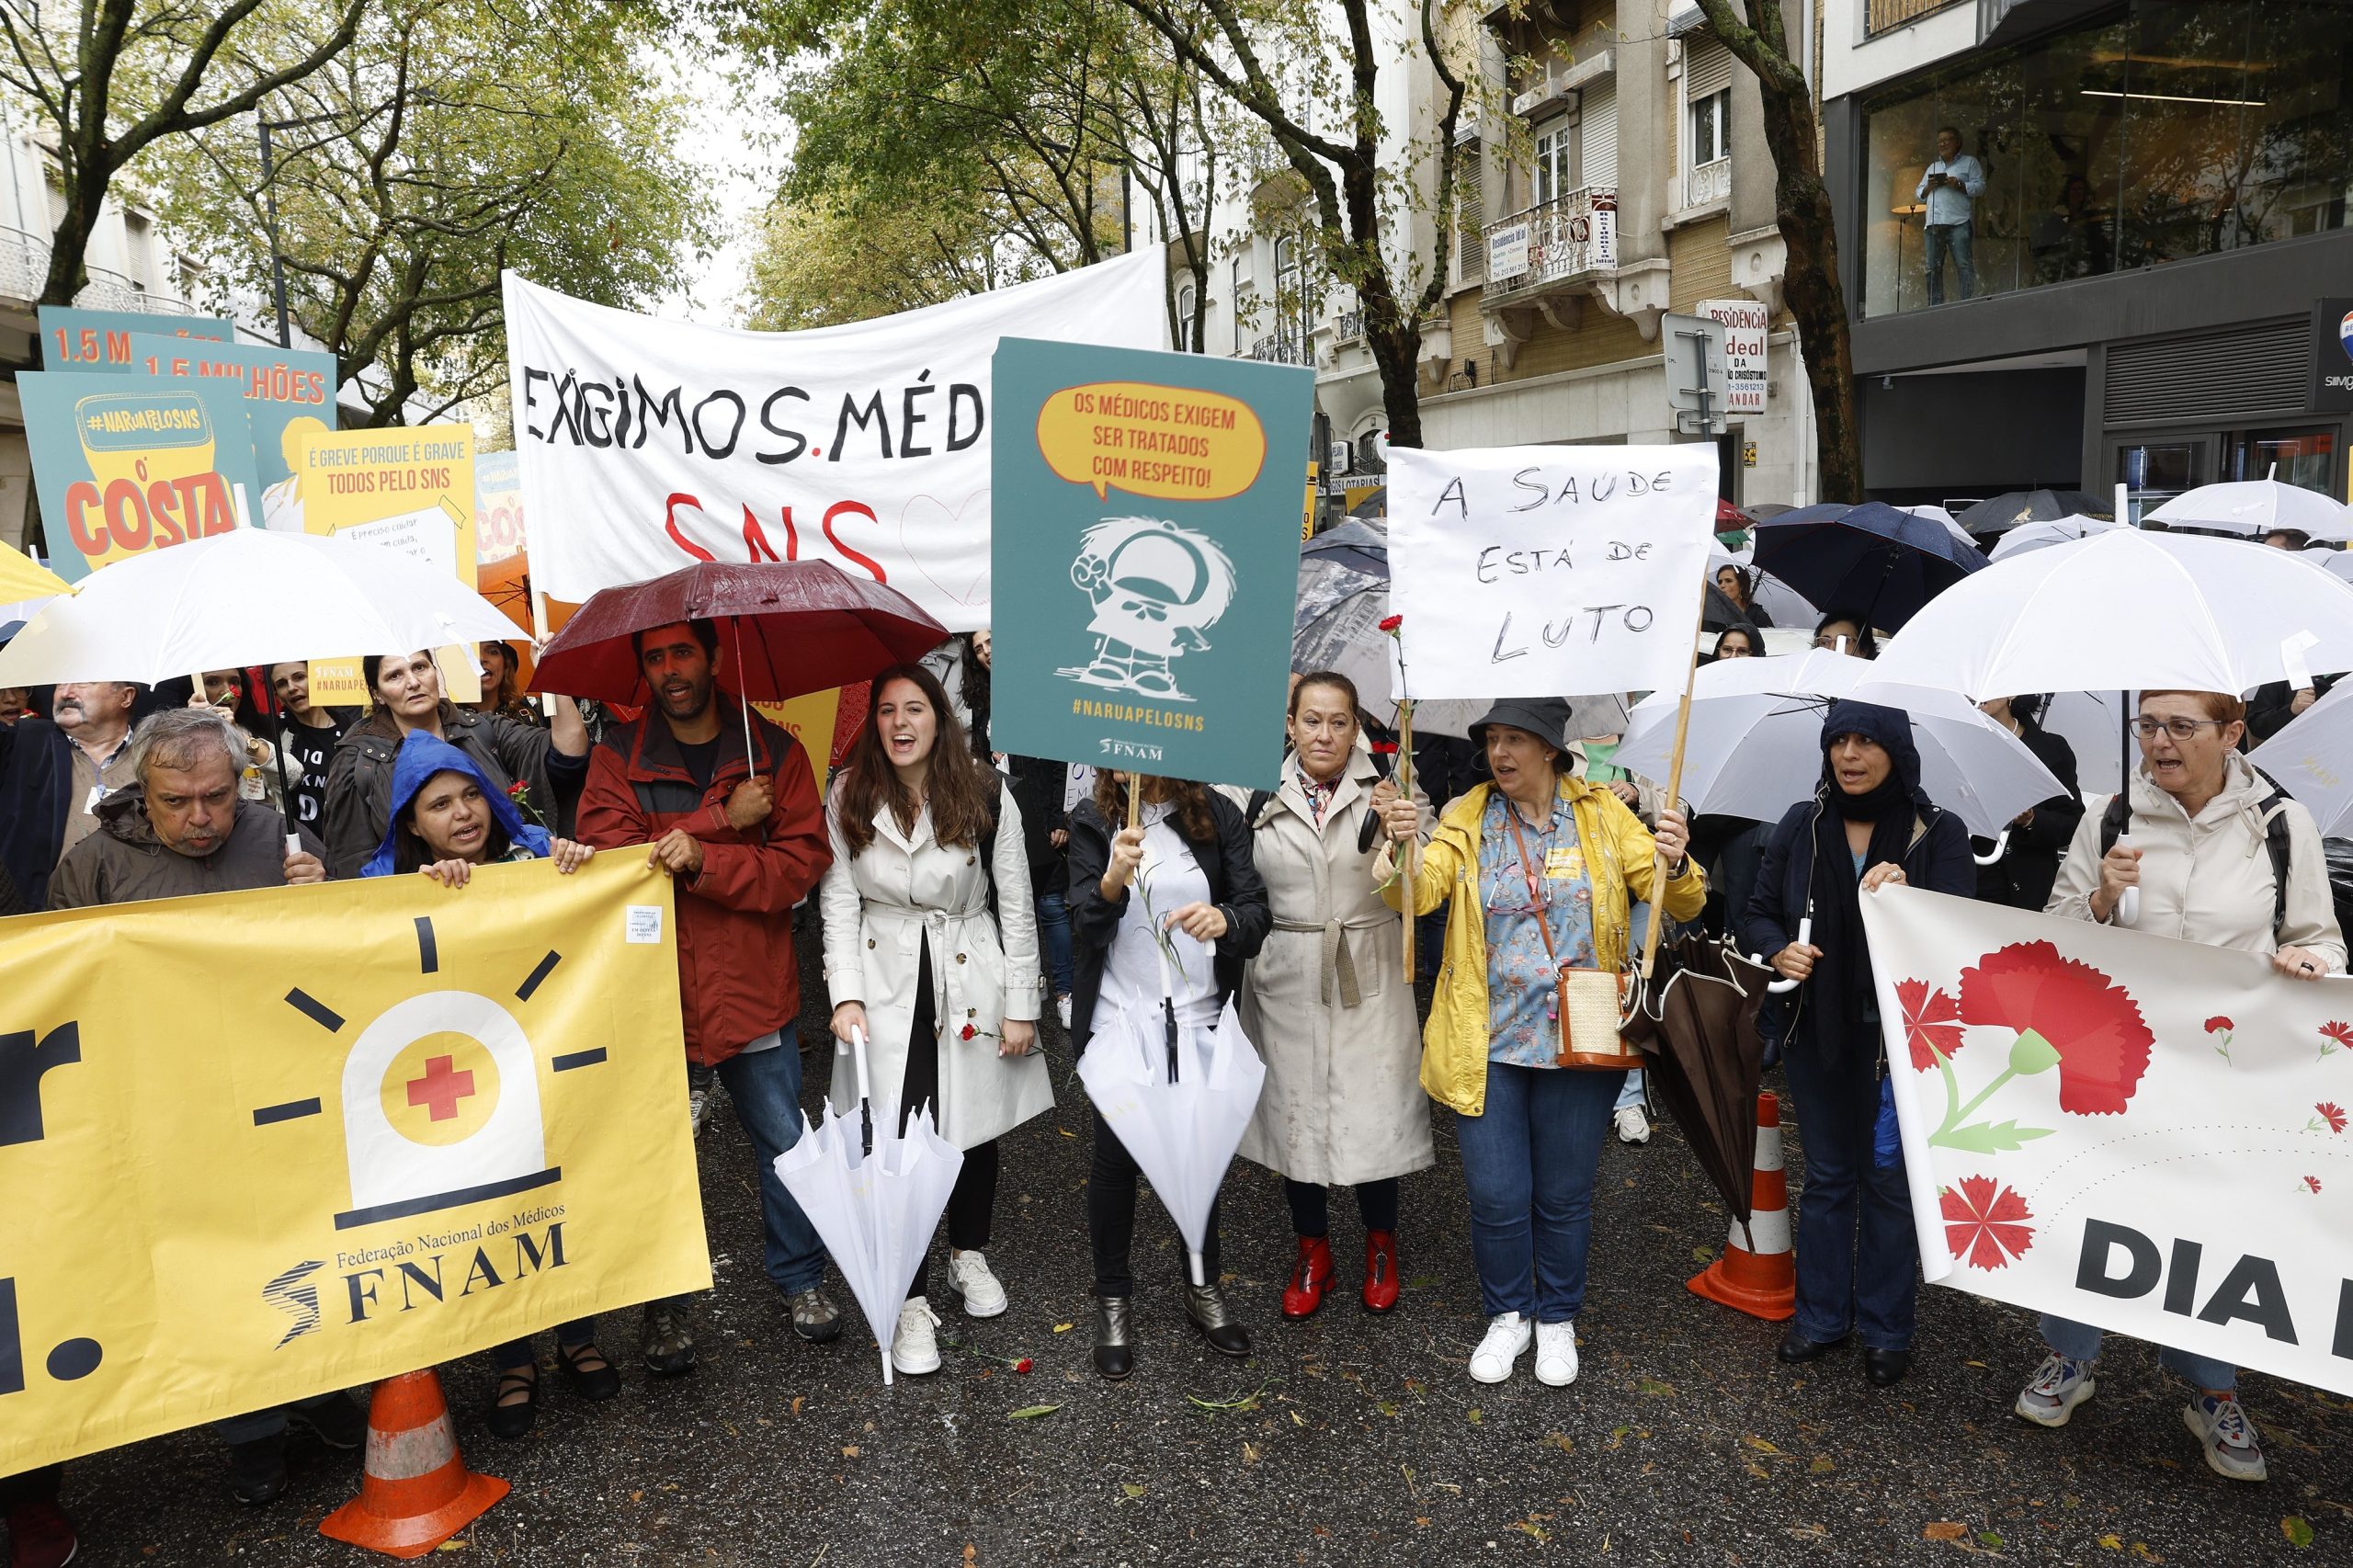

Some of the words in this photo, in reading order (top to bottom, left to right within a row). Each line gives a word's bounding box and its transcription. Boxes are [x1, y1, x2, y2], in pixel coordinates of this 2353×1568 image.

[1726, 335, 1763, 356] deal
[1733, 358, 1746, 368] DA
[1728, 382, 1765, 392] 1-3561213
[1729, 393, 1760, 406] ANDAR
[828, 369, 984, 461] MÉD
[1074, 392, 1094, 414] OS
[1099, 393, 1169, 423] MÉDICOS
[1174, 404, 1235, 430] EXIGEM
[309, 448, 316, 467] É
[320, 448, 358, 467] GREVE
[362, 445, 409, 464] PORQUE
[414, 441, 421, 461] É
[425, 441, 465, 460] GRAVE
[1094, 425, 1123, 448] SER
[1129, 428, 1210, 458] TRATADOS
[327, 472, 375, 494] TODOS
[380, 469, 416, 492] PELO
[421, 467, 450, 489] SNS
[1092, 456, 1127, 478] COM
[1131, 460, 1211, 489] RESPEITO!
[1431, 476, 1469, 522] A
[1507, 465, 1672, 513] SAÚDE
[64, 470, 238, 556] COSTA
[1477, 540, 1574, 585] ESTÁ
[1606, 540, 1653, 561] DE
[1491, 604, 1654, 664] LUTO
[316, 679, 368, 691] #NARUAPE
[1072, 699, 1205, 733] #NARUAPELOSNS
[1114, 743, 1163, 761] FNAM
[336, 1241, 414, 1268] Federação
[417, 1223, 483, 1252] Nacional
[486, 1221, 509, 1235] dos
[513, 1204, 565, 1230] Médicos
[340, 1221, 571, 1324] FNAM
[2075, 1217, 2300, 1346] DIA
